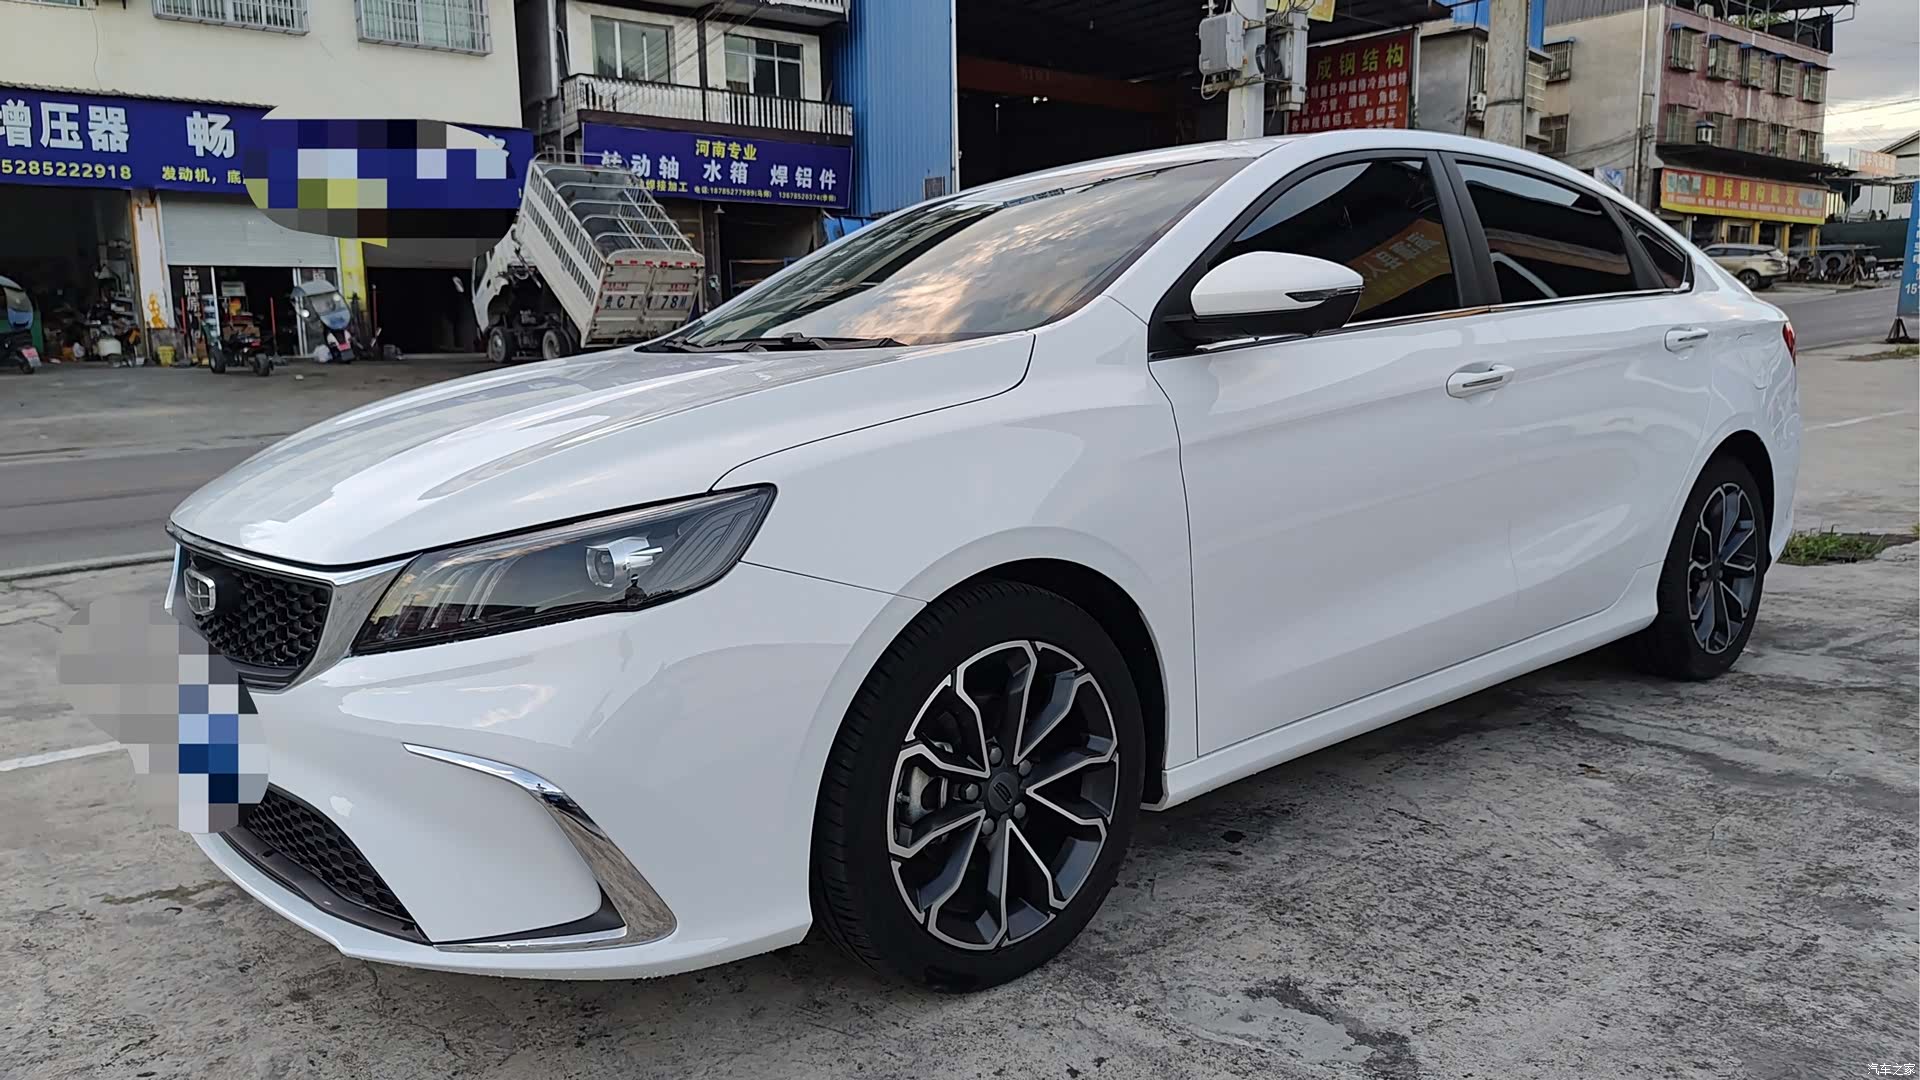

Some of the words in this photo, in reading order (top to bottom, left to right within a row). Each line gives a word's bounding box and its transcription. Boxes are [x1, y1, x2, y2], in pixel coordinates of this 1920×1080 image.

[0, 99, 129, 153] 增压器
[186, 111, 235, 159] 畅
[696, 138, 757, 161] 河南专业
[162, 166, 245, 185] 发动机，底
[703, 158, 749, 185] 水箱
[770, 164, 837, 191] 焊铝件
